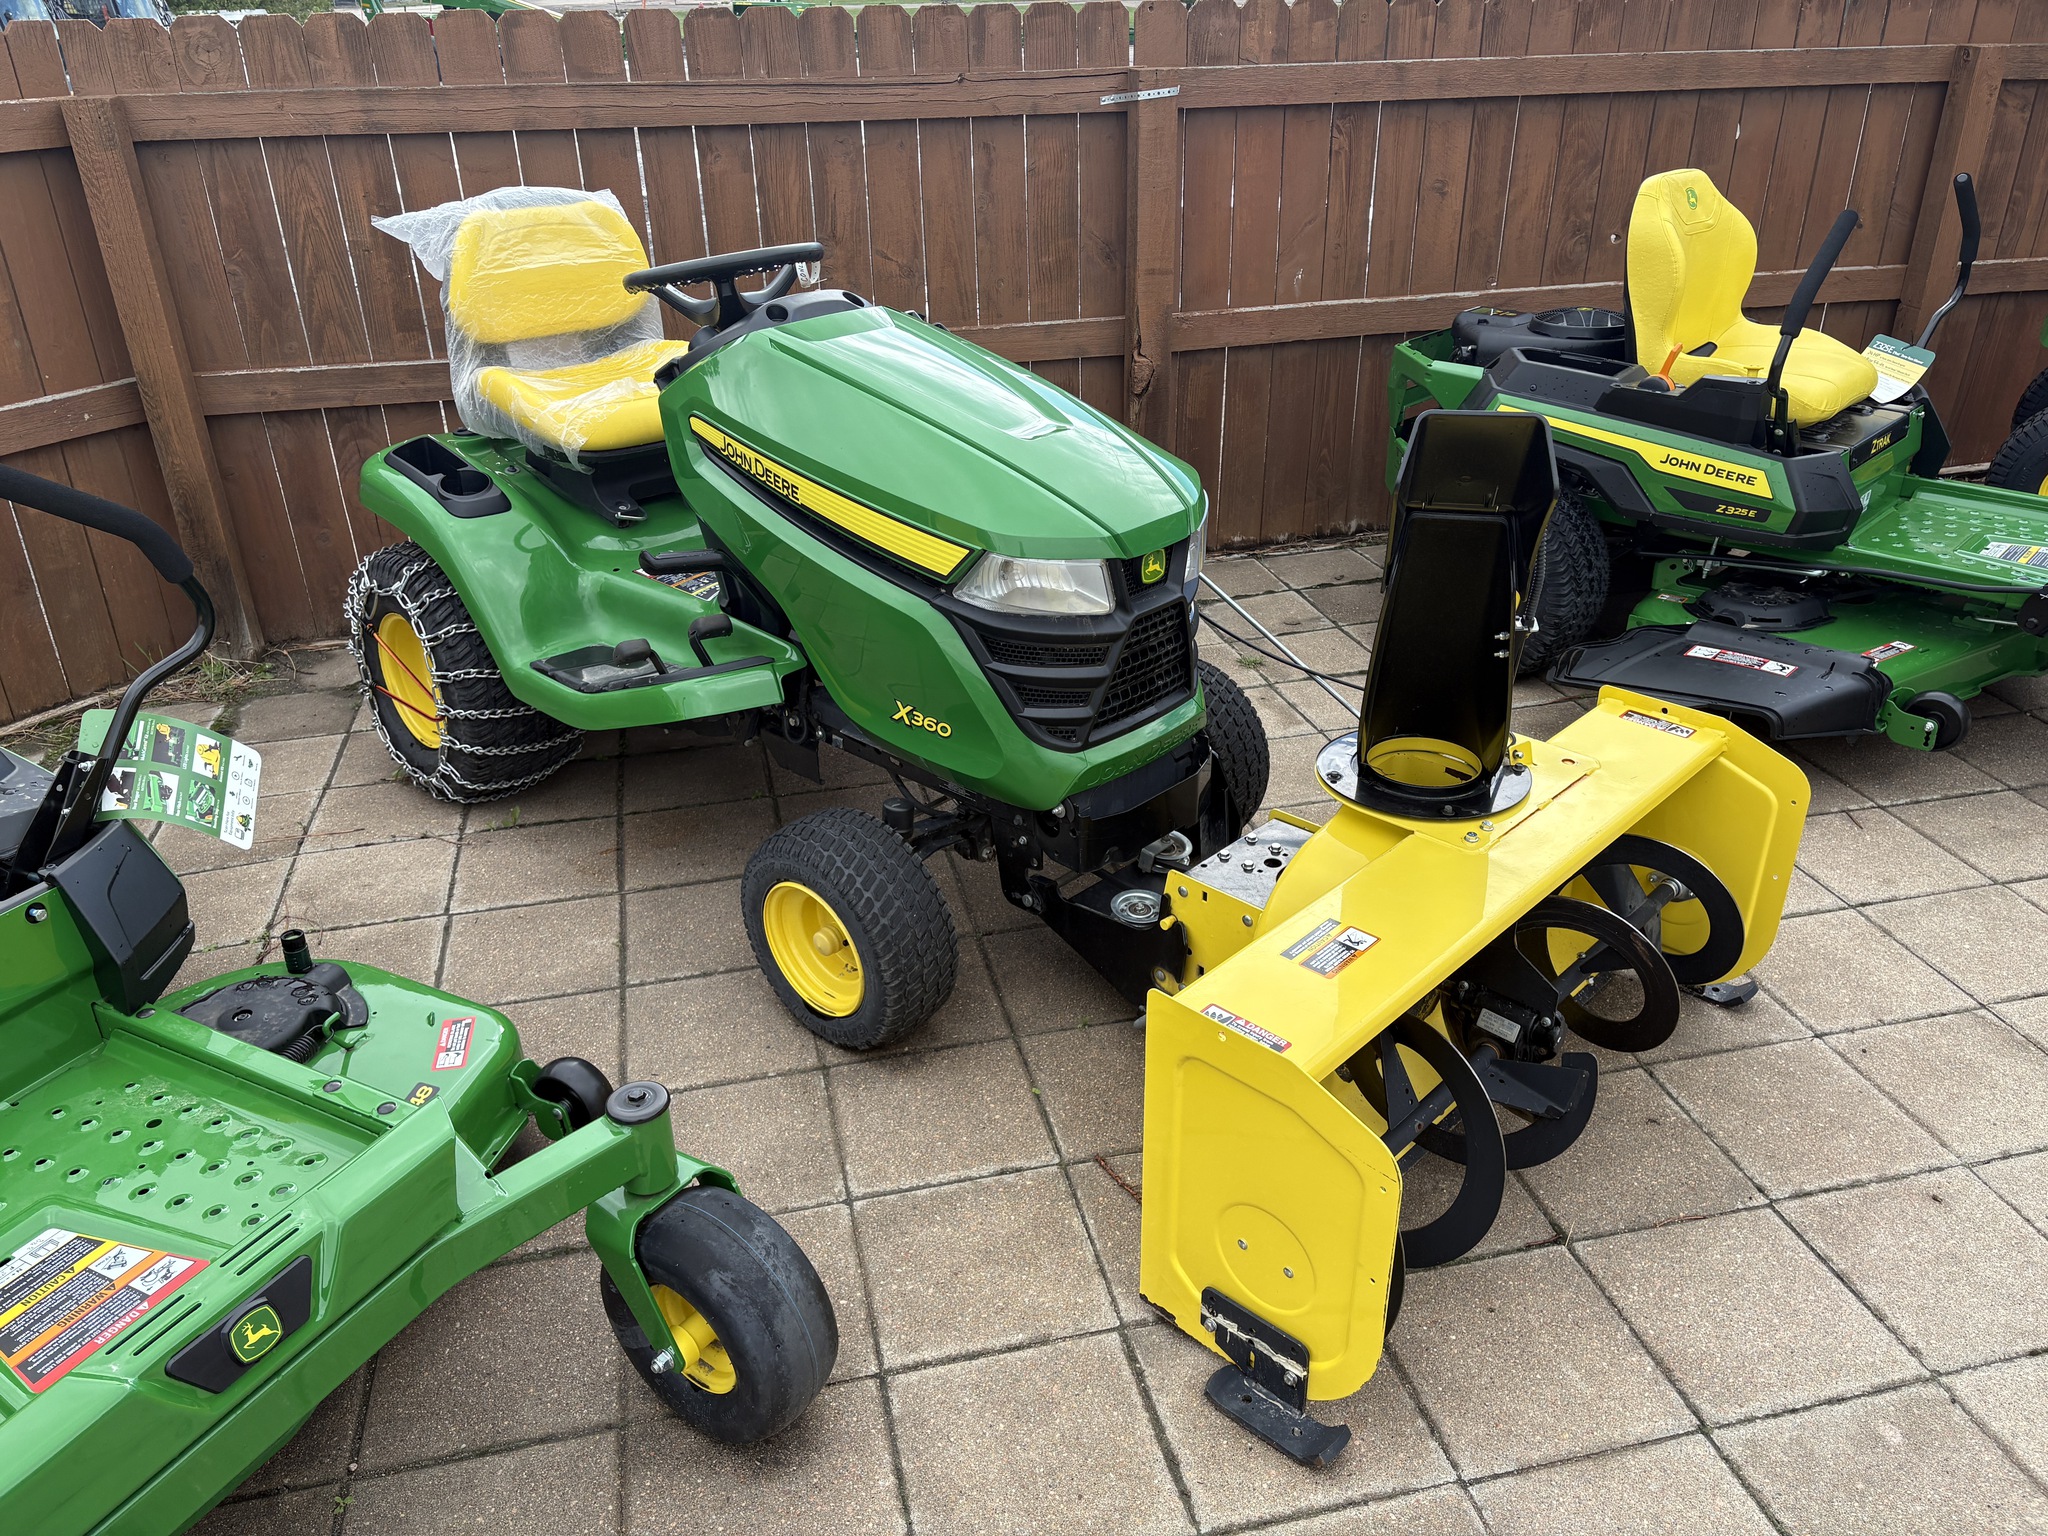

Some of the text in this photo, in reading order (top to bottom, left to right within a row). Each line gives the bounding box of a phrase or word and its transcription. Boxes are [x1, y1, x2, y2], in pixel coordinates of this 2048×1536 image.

[1871, 432, 1892, 454] ZTRAK
[720, 435, 801, 502] JOHN DEERE
[1659, 453, 1758, 486] JOHN DEERE
[1715, 503, 1758, 518] Z325E
[890, 699, 952, 738] X360
[1246, 1022, 1288, 1048] DANGER
[20, 1275, 67, 1308] CAUTION
[56, 1290, 109, 1329] WARNING
[94, 1311, 140, 1345] DANGER
